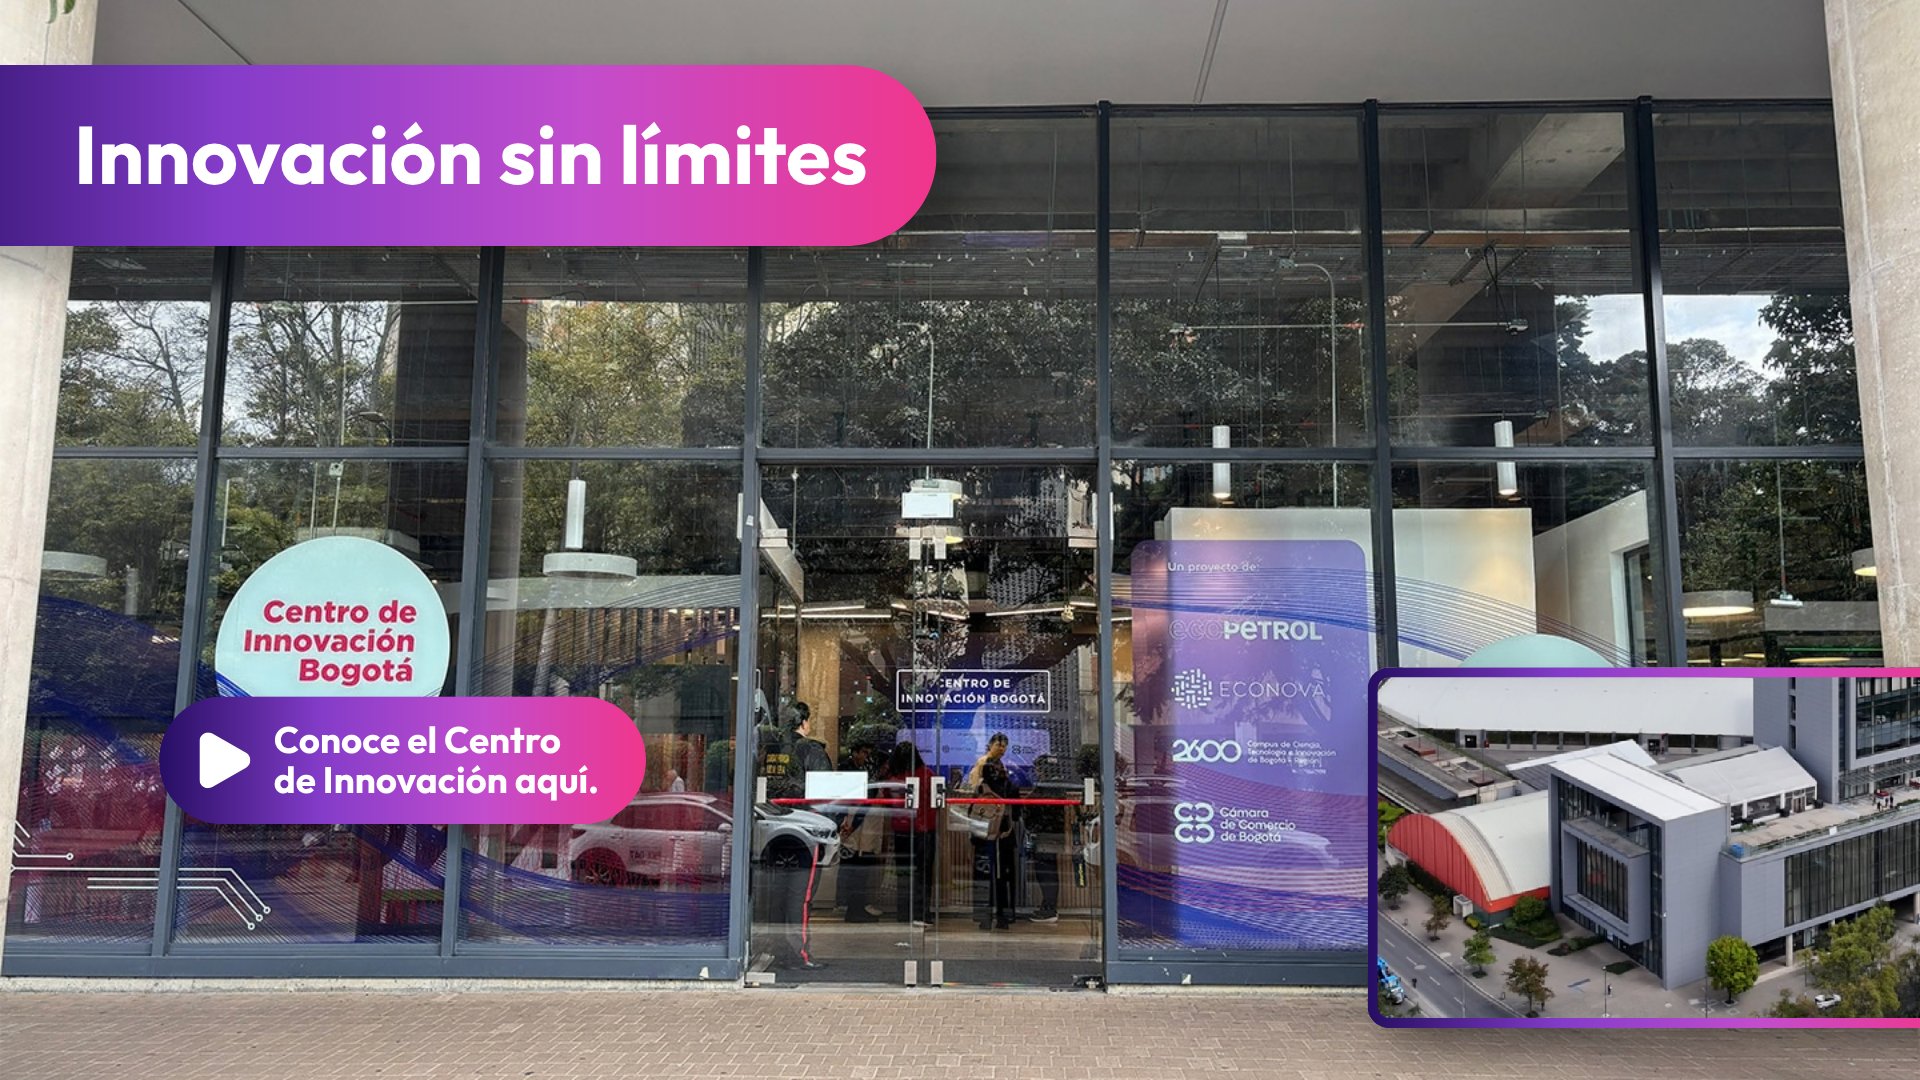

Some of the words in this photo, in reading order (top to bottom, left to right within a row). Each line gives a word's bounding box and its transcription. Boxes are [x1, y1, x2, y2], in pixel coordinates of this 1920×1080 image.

[1167, 562, 1185, 572] Un
[1188, 562, 1239, 573] proyecto
[263, 600, 369, 624] Centro
[378, 600, 417, 624] de
[243, 628, 415, 652] Innovación
[299, 657, 413, 687] Bogotá
[993, 678, 1011, 688] DE
[1219, 681, 1326, 698] ECONOVA
[990, 691, 1046, 704] BOGOTÁ
[1172, 739, 1242, 763] 2600
[1280, 740, 1291, 749] de
[1219, 807, 1269, 818] Cámara
[1220, 819, 1236, 830] de
[1238, 819, 1296, 830] Comercio
[1220, 831, 1236, 842] de
[1239, 831, 1281, 844] Bogotá
